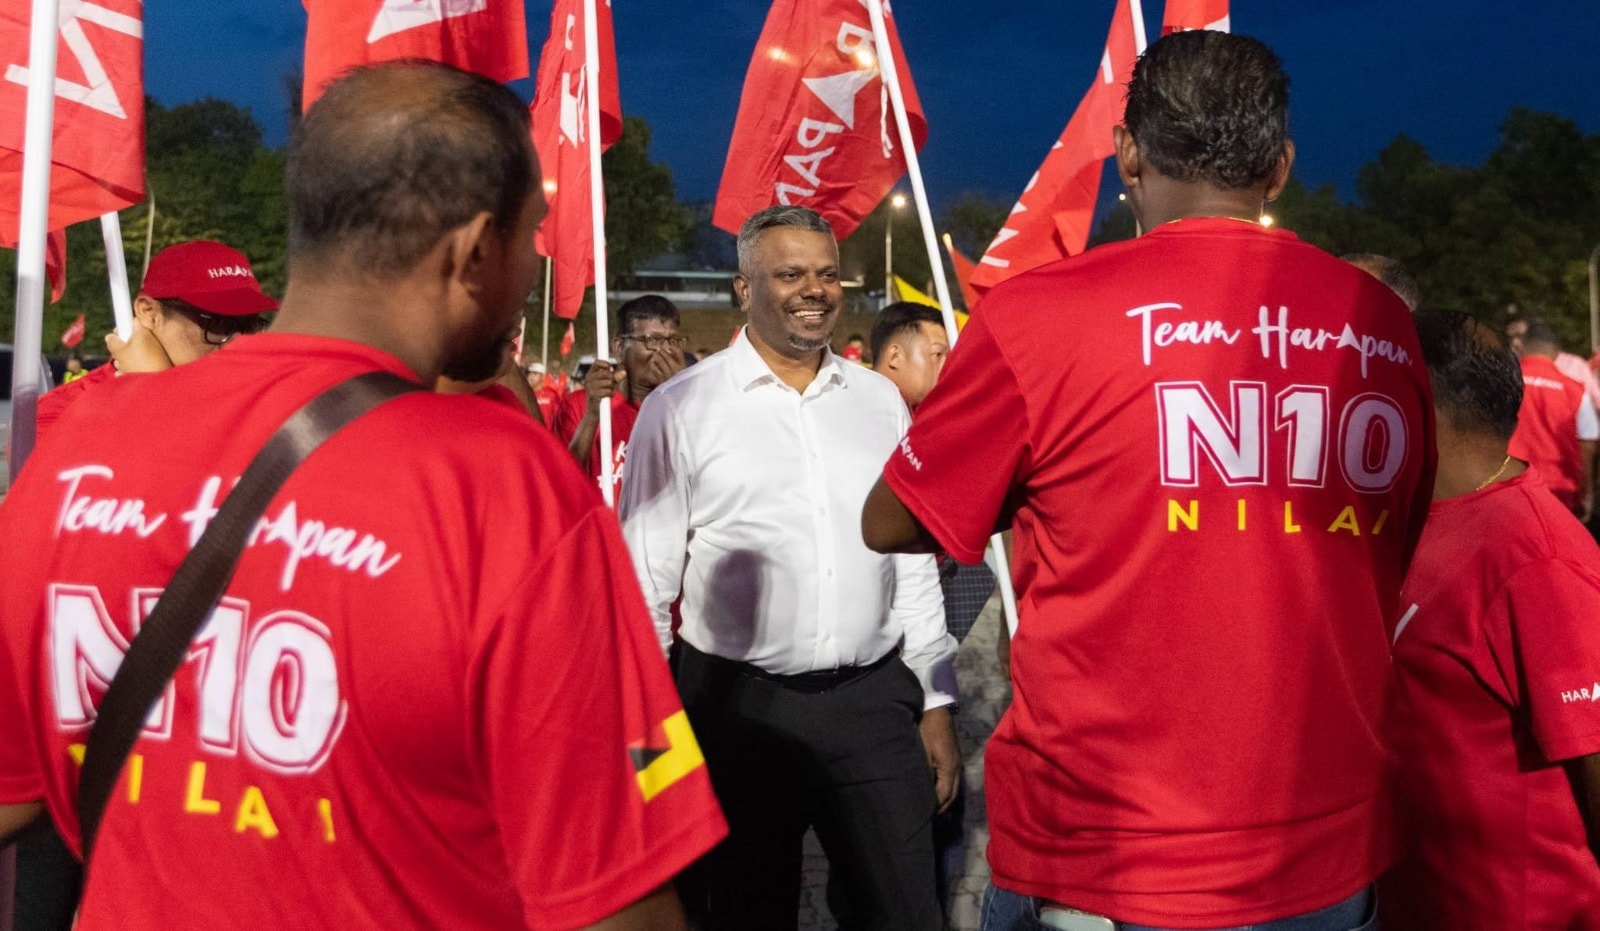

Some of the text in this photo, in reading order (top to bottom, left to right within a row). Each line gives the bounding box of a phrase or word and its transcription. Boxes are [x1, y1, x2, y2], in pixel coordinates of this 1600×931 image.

[1126, 301, 1241, 366] Team
[1154, 380, 1410, 494] N10
[57, 464, 167, 538] Team
[1167, 499, 1389, 537] NILAI
[47, 582, 349, 775] N10
[67, 743, 337, 843] ILAI
